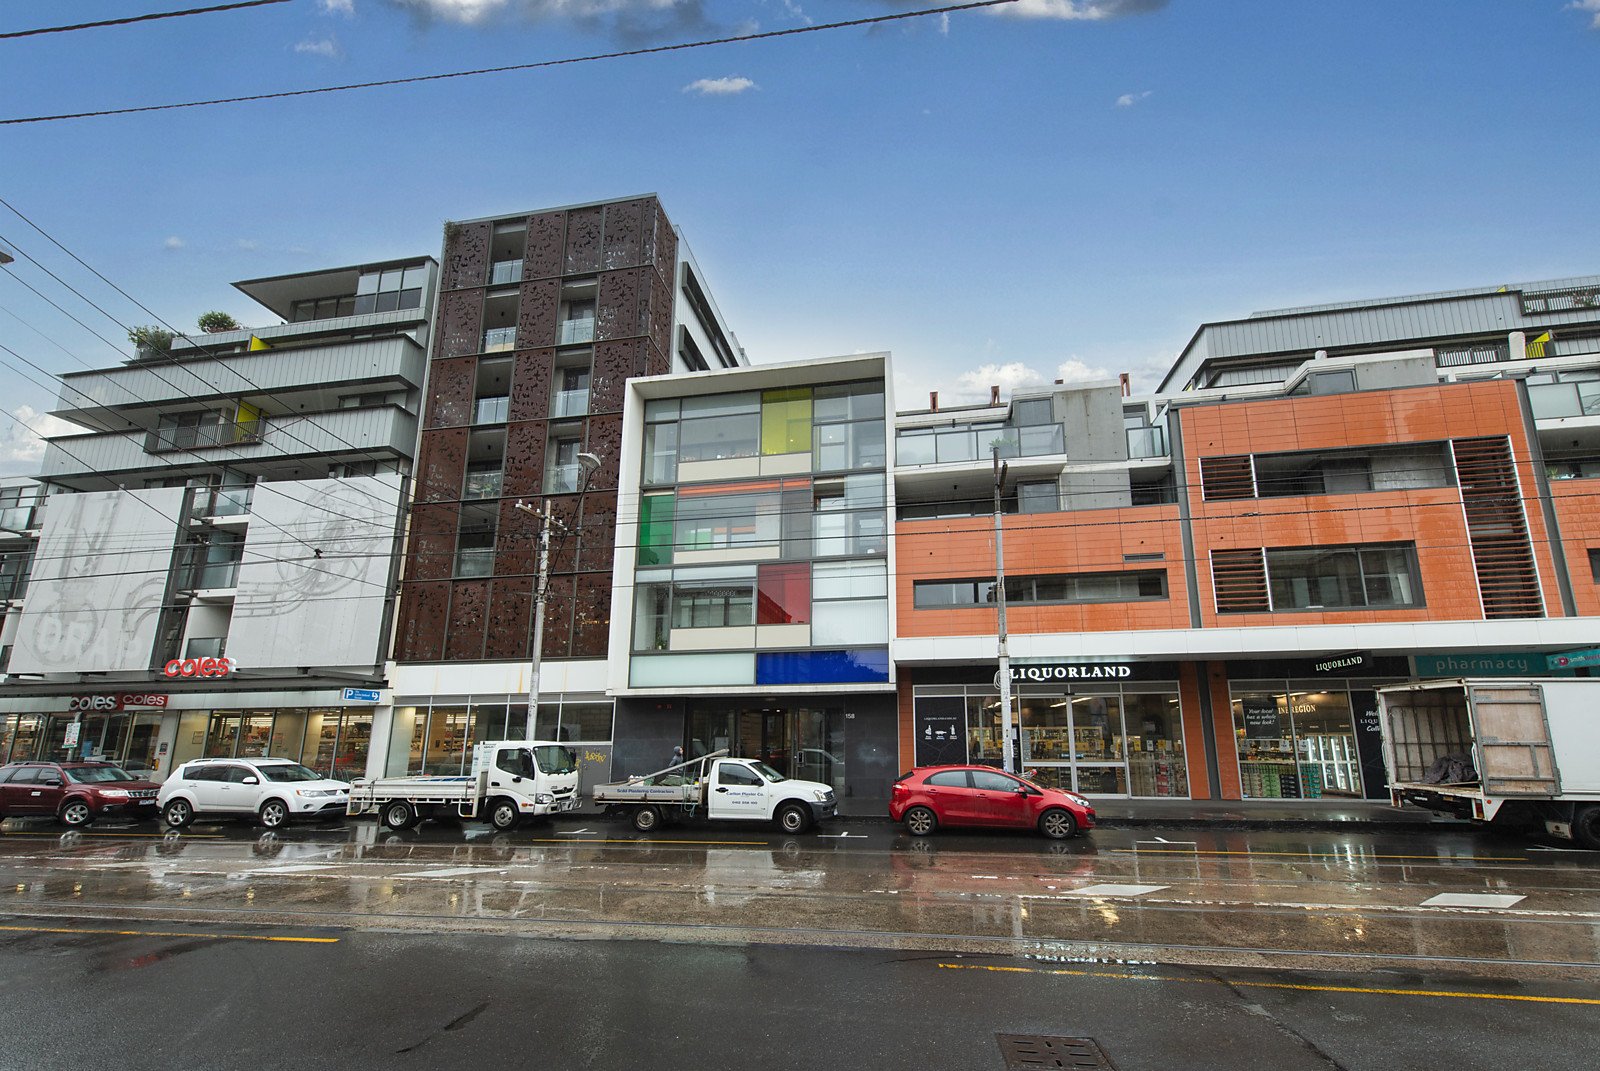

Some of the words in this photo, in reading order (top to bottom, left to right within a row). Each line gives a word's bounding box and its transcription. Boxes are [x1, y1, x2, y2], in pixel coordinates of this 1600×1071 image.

[164, 656, 230, 677] coles
[1315, 656, 1363, 672] LIQUORLAND
[1436, 657, 1528, 673] pharmacy
[1010, 666, 1131, 681] LIQUORLAND
[69, 695, 117, 711] coles
[123, 694, 165, 706] coles
[1291, 704, 1316, 714] REGION
